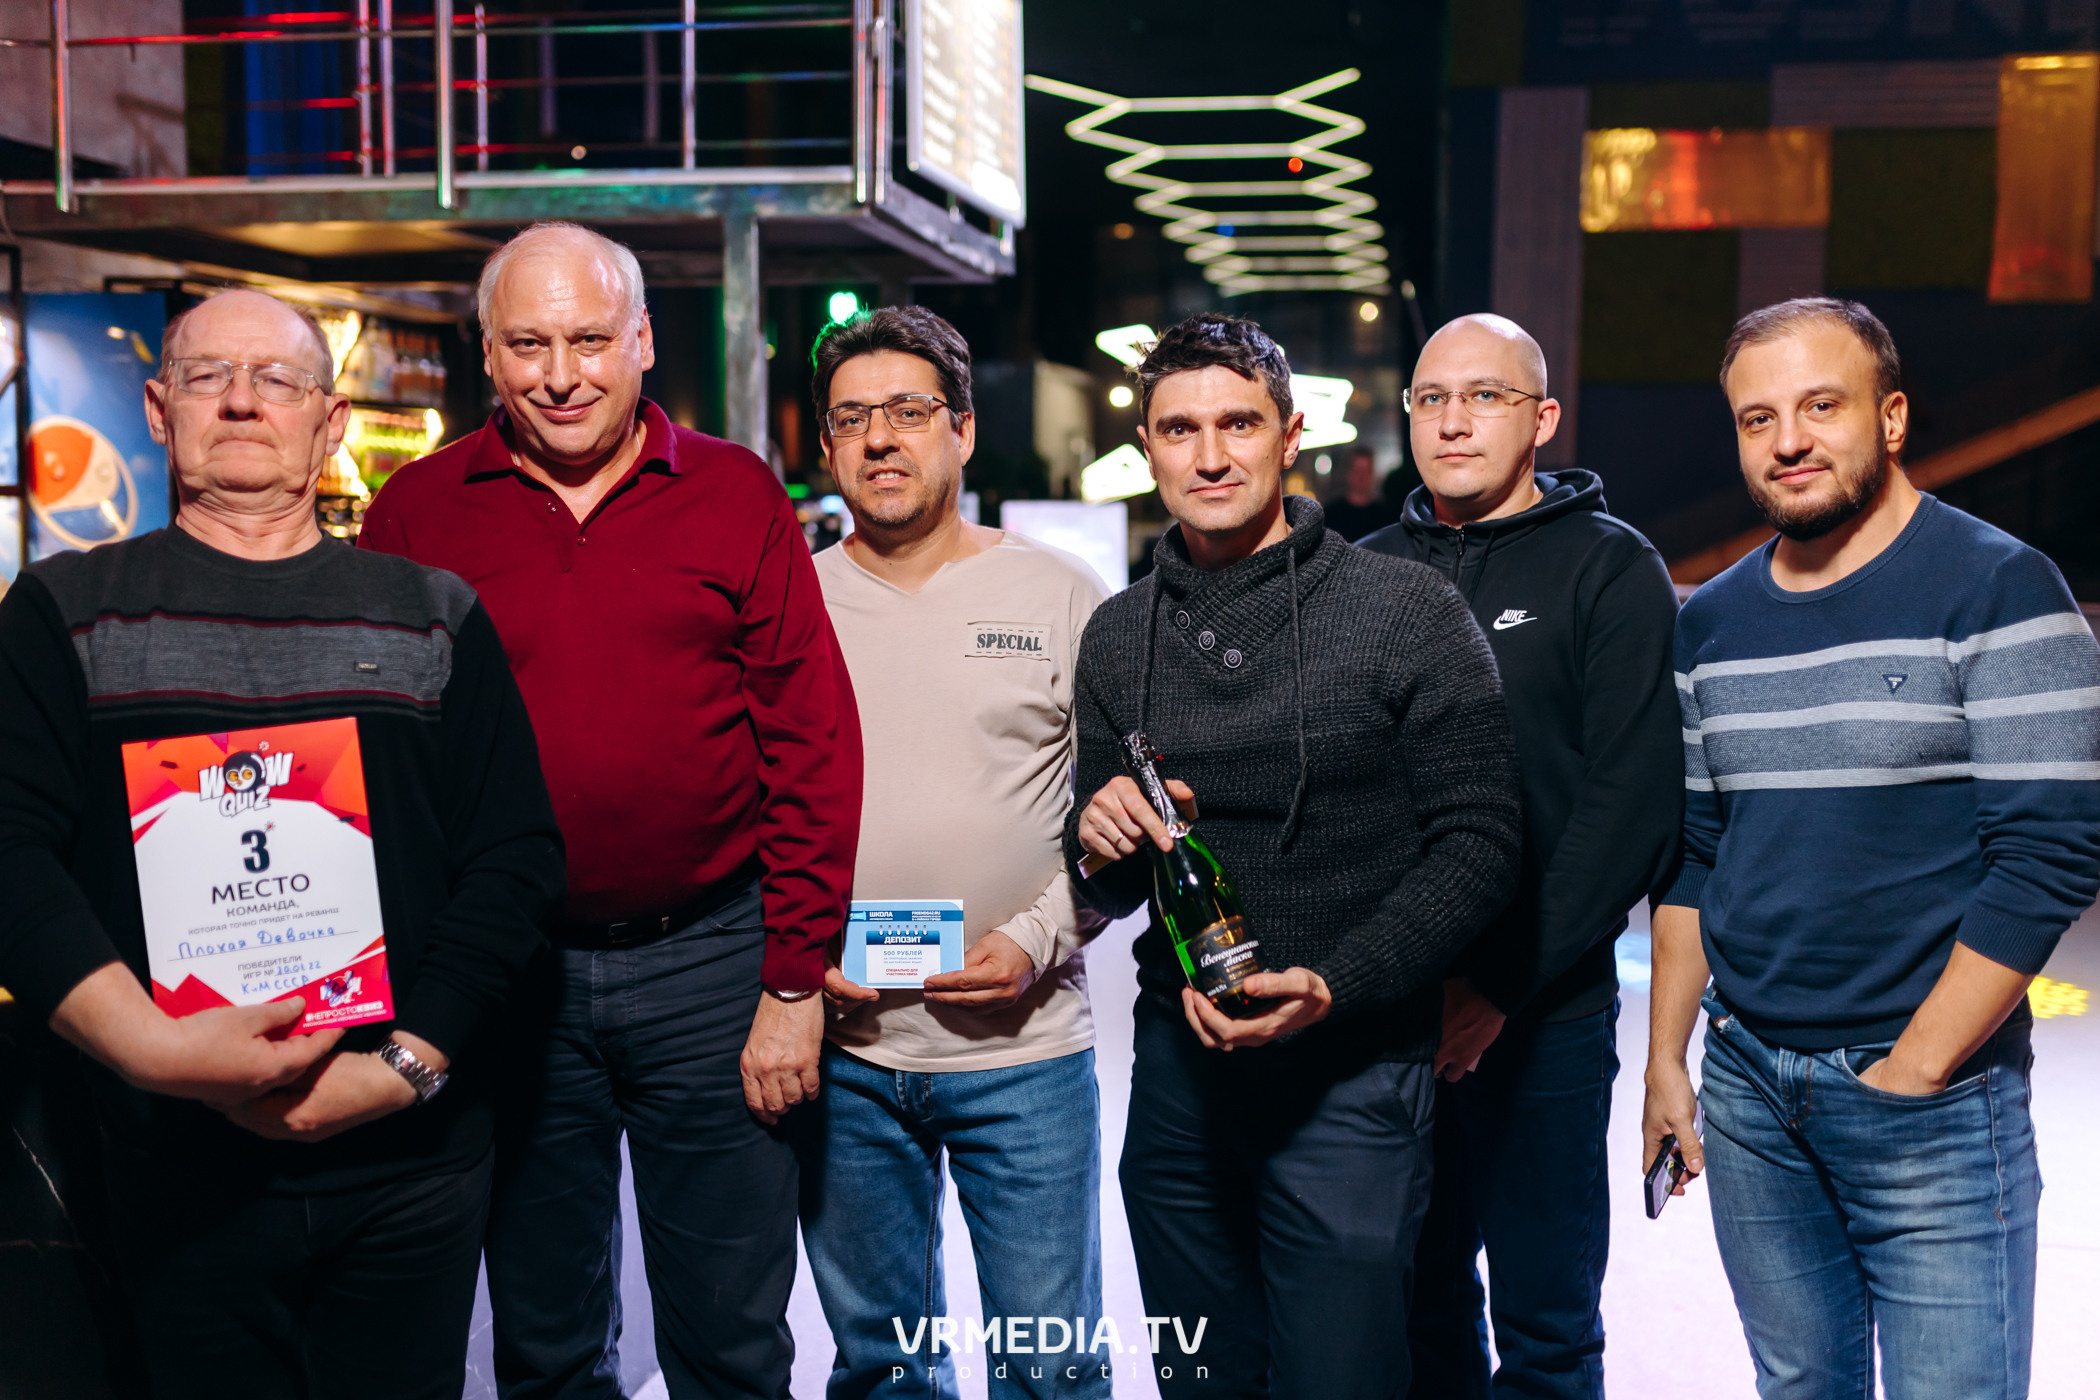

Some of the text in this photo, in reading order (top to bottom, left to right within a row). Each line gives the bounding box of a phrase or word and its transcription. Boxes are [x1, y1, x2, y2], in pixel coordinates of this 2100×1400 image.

[1501, 609, 1527, 622] NIKE
[977, 633, 1042, 651] SPECIAL
[219, 784, 271, 818] QUIZ
[241, 829, 270, 873] 3
[212, 873, 310, 904] МЕСТО
[226, 899, 300, 918] КОМАНДА,
[188, 907, 339, 935] КОТОРАЯ ТОЧНО ПРИДЕТ НА РЕВАНШ
[178, 927, 335, 959] Плохая Девочка
[884, 936, 922, 944] ДЕПОЗИТ
[238, 955, 302, 971] ПОБЕДИТЕЛИ
[243, 970, 261, 980] ИГР
